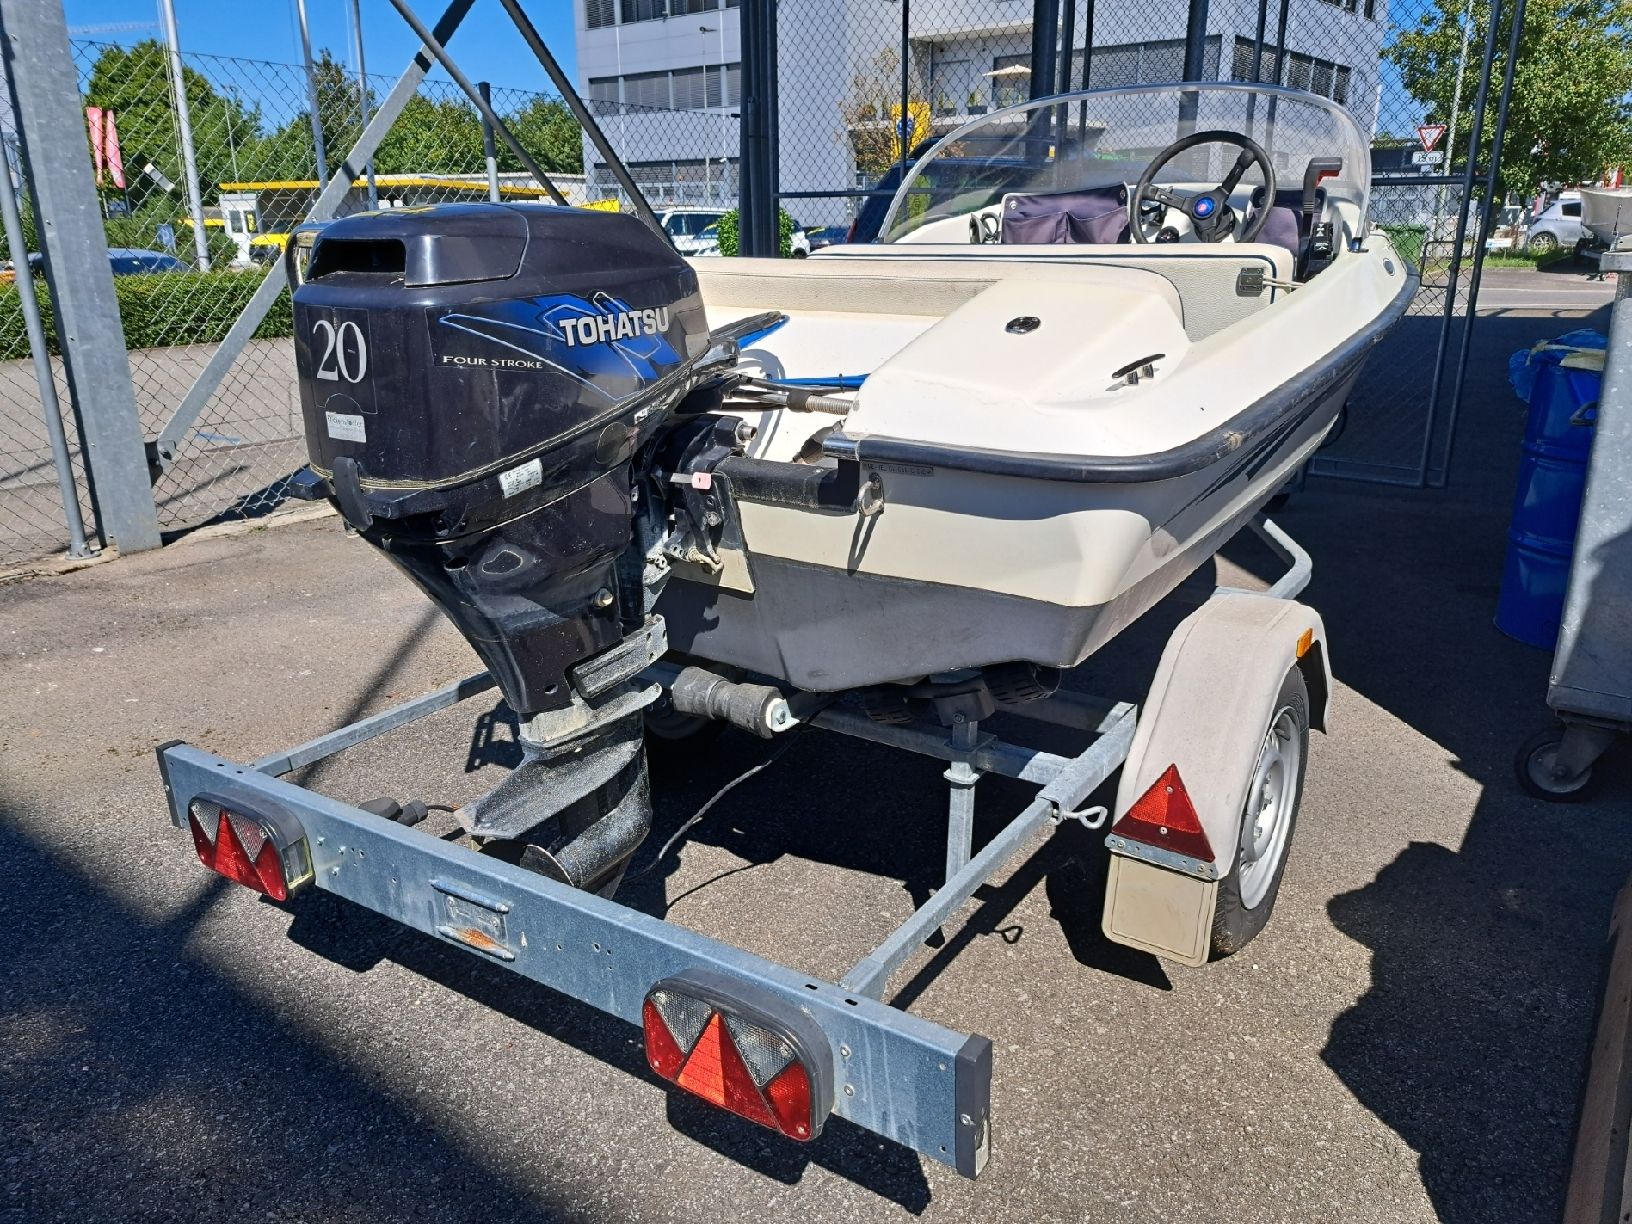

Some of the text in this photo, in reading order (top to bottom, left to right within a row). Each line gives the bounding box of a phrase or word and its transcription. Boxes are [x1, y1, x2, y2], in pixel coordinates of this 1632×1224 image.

[559, 306, 669, 346] TOHATSU
[313, 320, 367, 384] 20
[442, 355, 543, 369] FOUR STROKE
